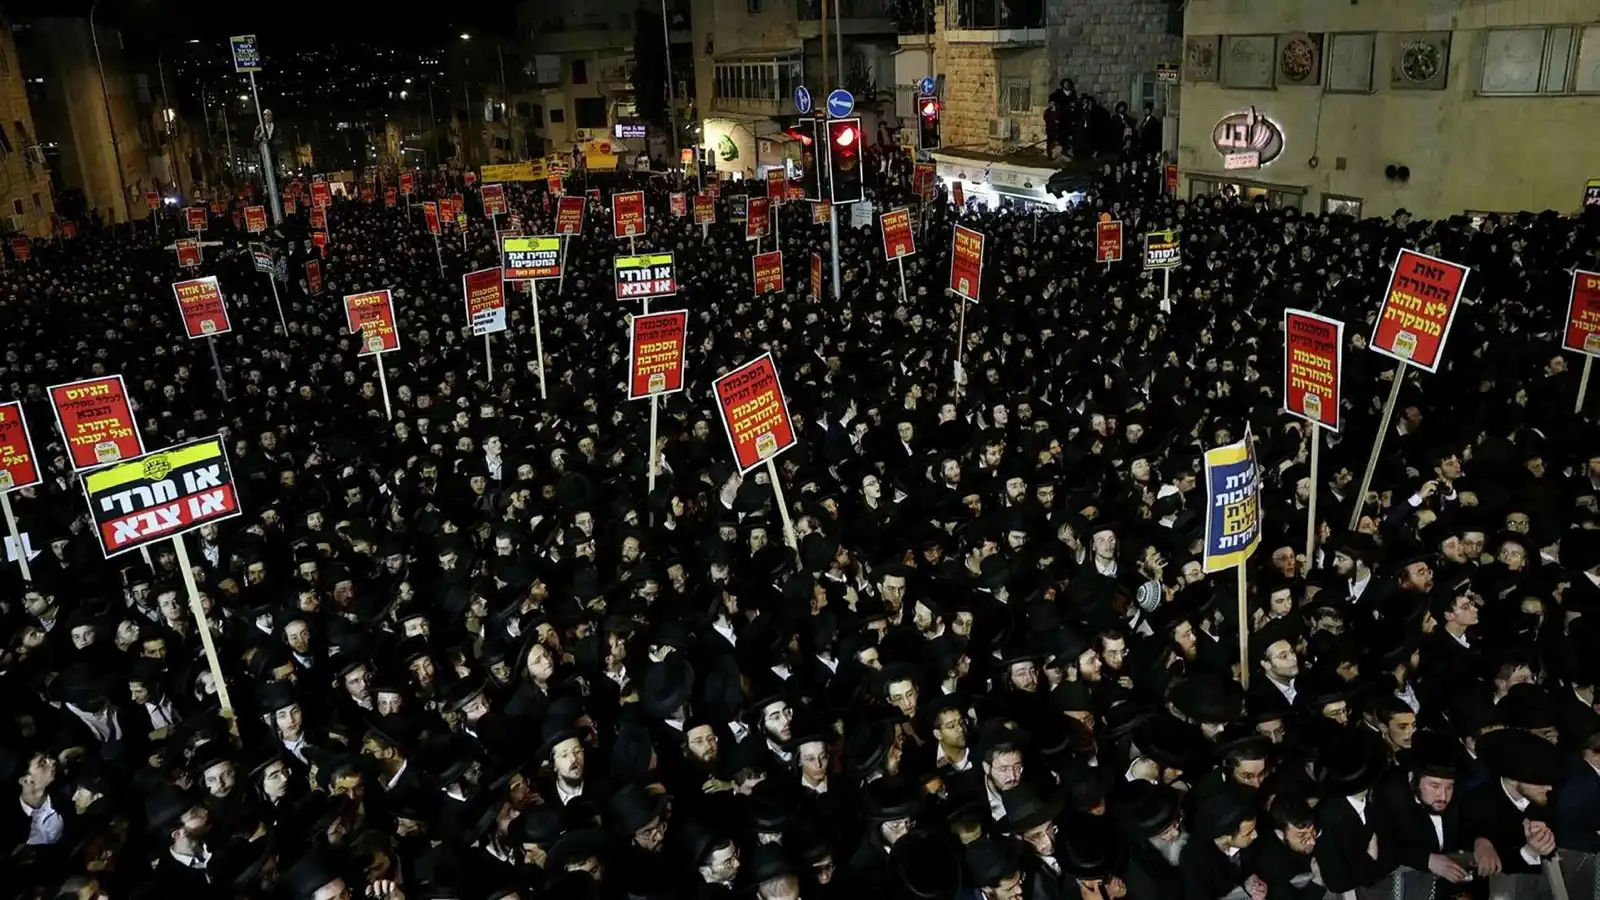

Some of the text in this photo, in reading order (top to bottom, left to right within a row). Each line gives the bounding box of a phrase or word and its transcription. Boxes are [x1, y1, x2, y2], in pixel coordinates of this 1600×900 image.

[508, 251, 557, 260] תחזירו את
[510, 259, 556, 268] החטופים!
[1148, 248, 1174, 258] לסחר
[620, 266, 670, 282] או חרדי
[1412, 260, 1446, 281] זאת
[178, 282, 216, 296] אין אחד
[622, 280, 670, 297] או צבא
[1396, 275, 1450, 301] התורה
[1389, 290, 1448, 318] לא תהא
[640, 340, 678, 354] הסכמה
[637, 350, 679, 366] להחרבת
[637, 361, 678, 376] היהדות
[1293, 348, 1332, 371] הסכמה
[723, 364, 766, 392] הסכמה
[1291, 363, 1334, 385] להחרבת
[66, 384, 110, 400] הגיוס
[724, 374, 774, 406] לחוק הגיוס
[1292, 376, 1332, 399] היהדות
[76, 406, 112, 420] הצבא
[732, 390, 774, 420] הסכמה
[77, 418, 120, 434] ביהרג
[734, 400, 780, 433] להחרבת
[70, 428, 134, 446] ואל יעבור
[739, 414, 783, 444] היהדות
[182, 464, 222, 494] או
[100, 478, 178, 514] חרדי
[112, 489, 227, 544] או צבא
